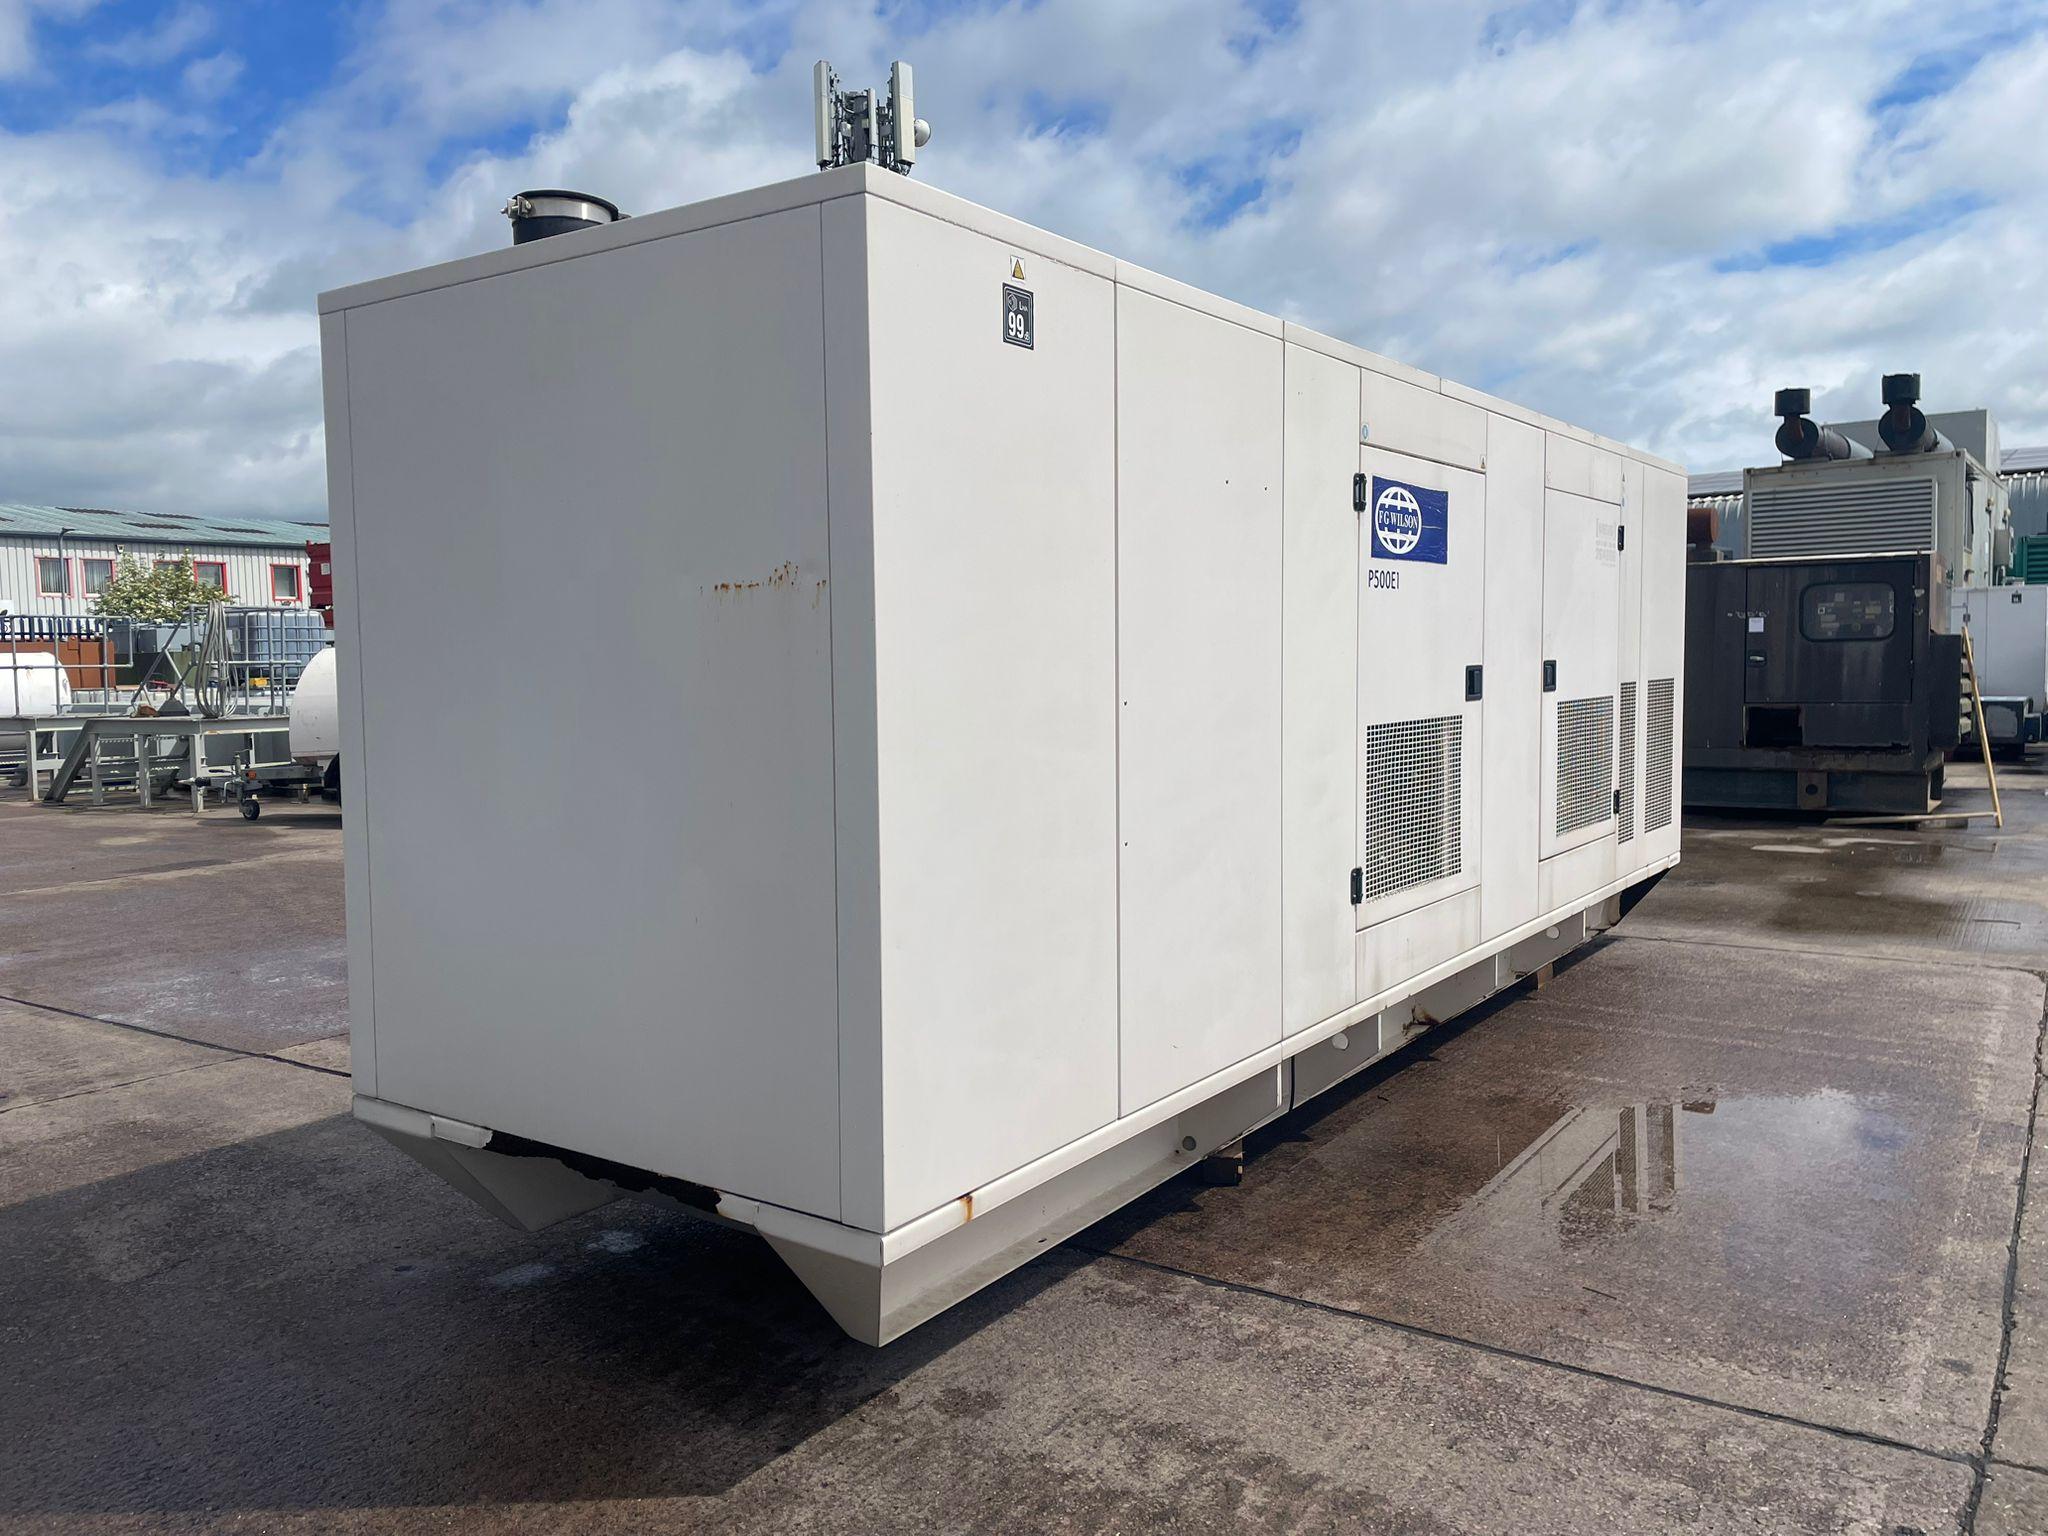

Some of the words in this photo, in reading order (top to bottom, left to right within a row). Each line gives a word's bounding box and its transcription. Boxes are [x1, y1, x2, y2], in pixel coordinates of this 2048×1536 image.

[1008, 311, 1025, 339] 99
[1390, 511, 1418, 529] WILSON
[1368, 569, 1400, 590] P500E1
